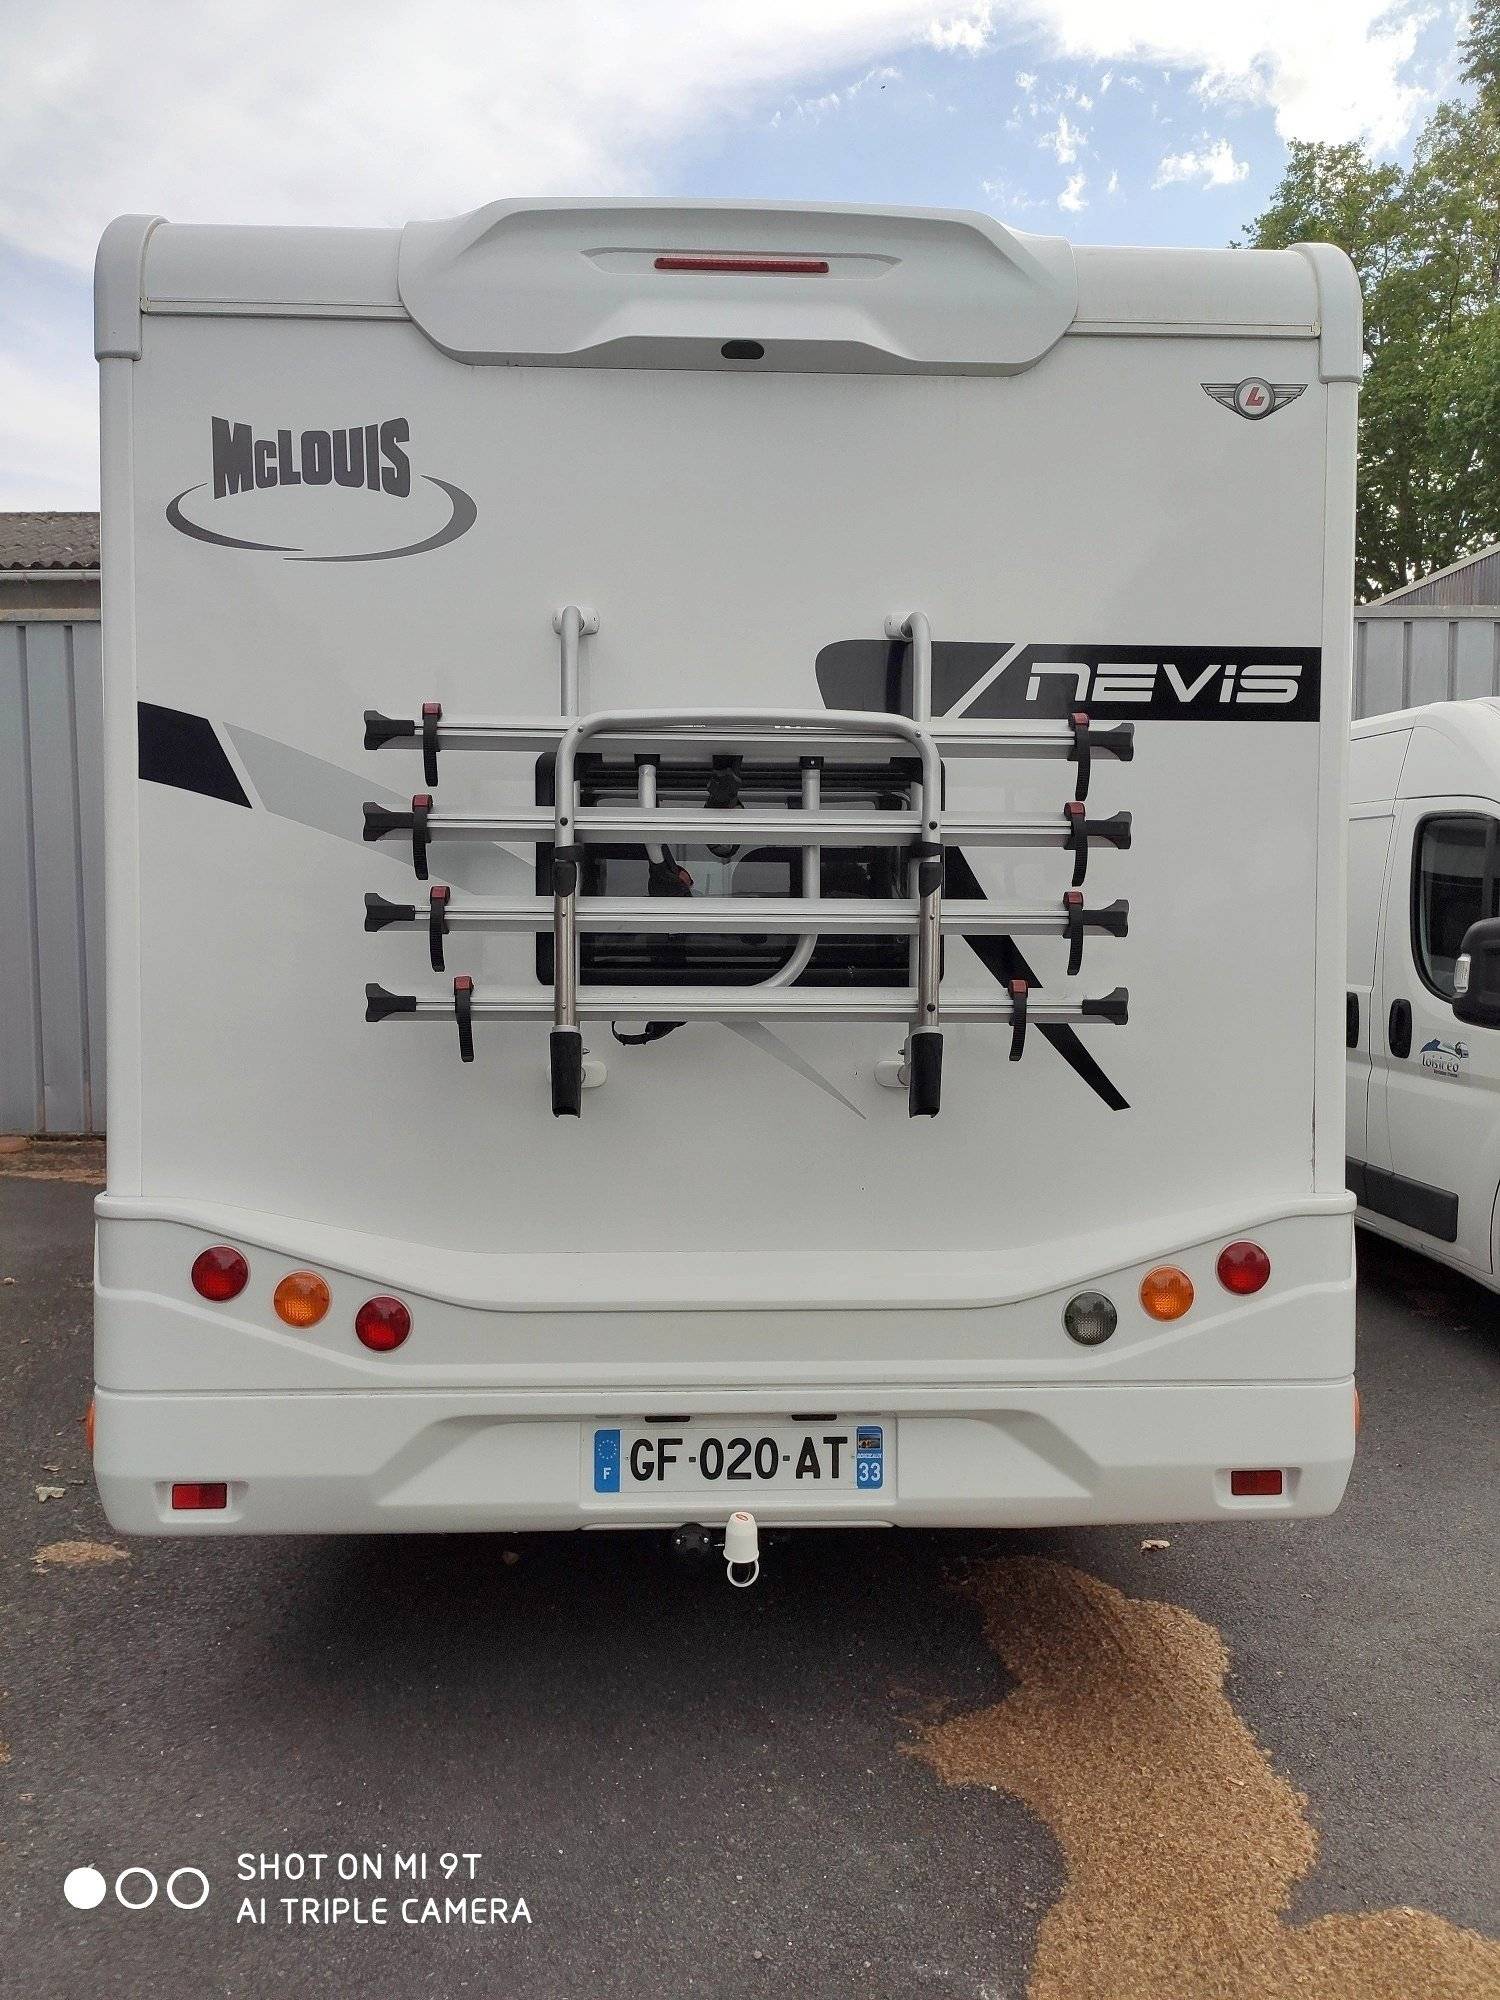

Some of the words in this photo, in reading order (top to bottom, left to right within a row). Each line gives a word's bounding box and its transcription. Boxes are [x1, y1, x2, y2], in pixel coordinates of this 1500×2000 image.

[602, 1467, 612, 1480] F
[630, 1436, 848, 1481] GF-020-AT
[858, 1462, 881, 1482] 33
